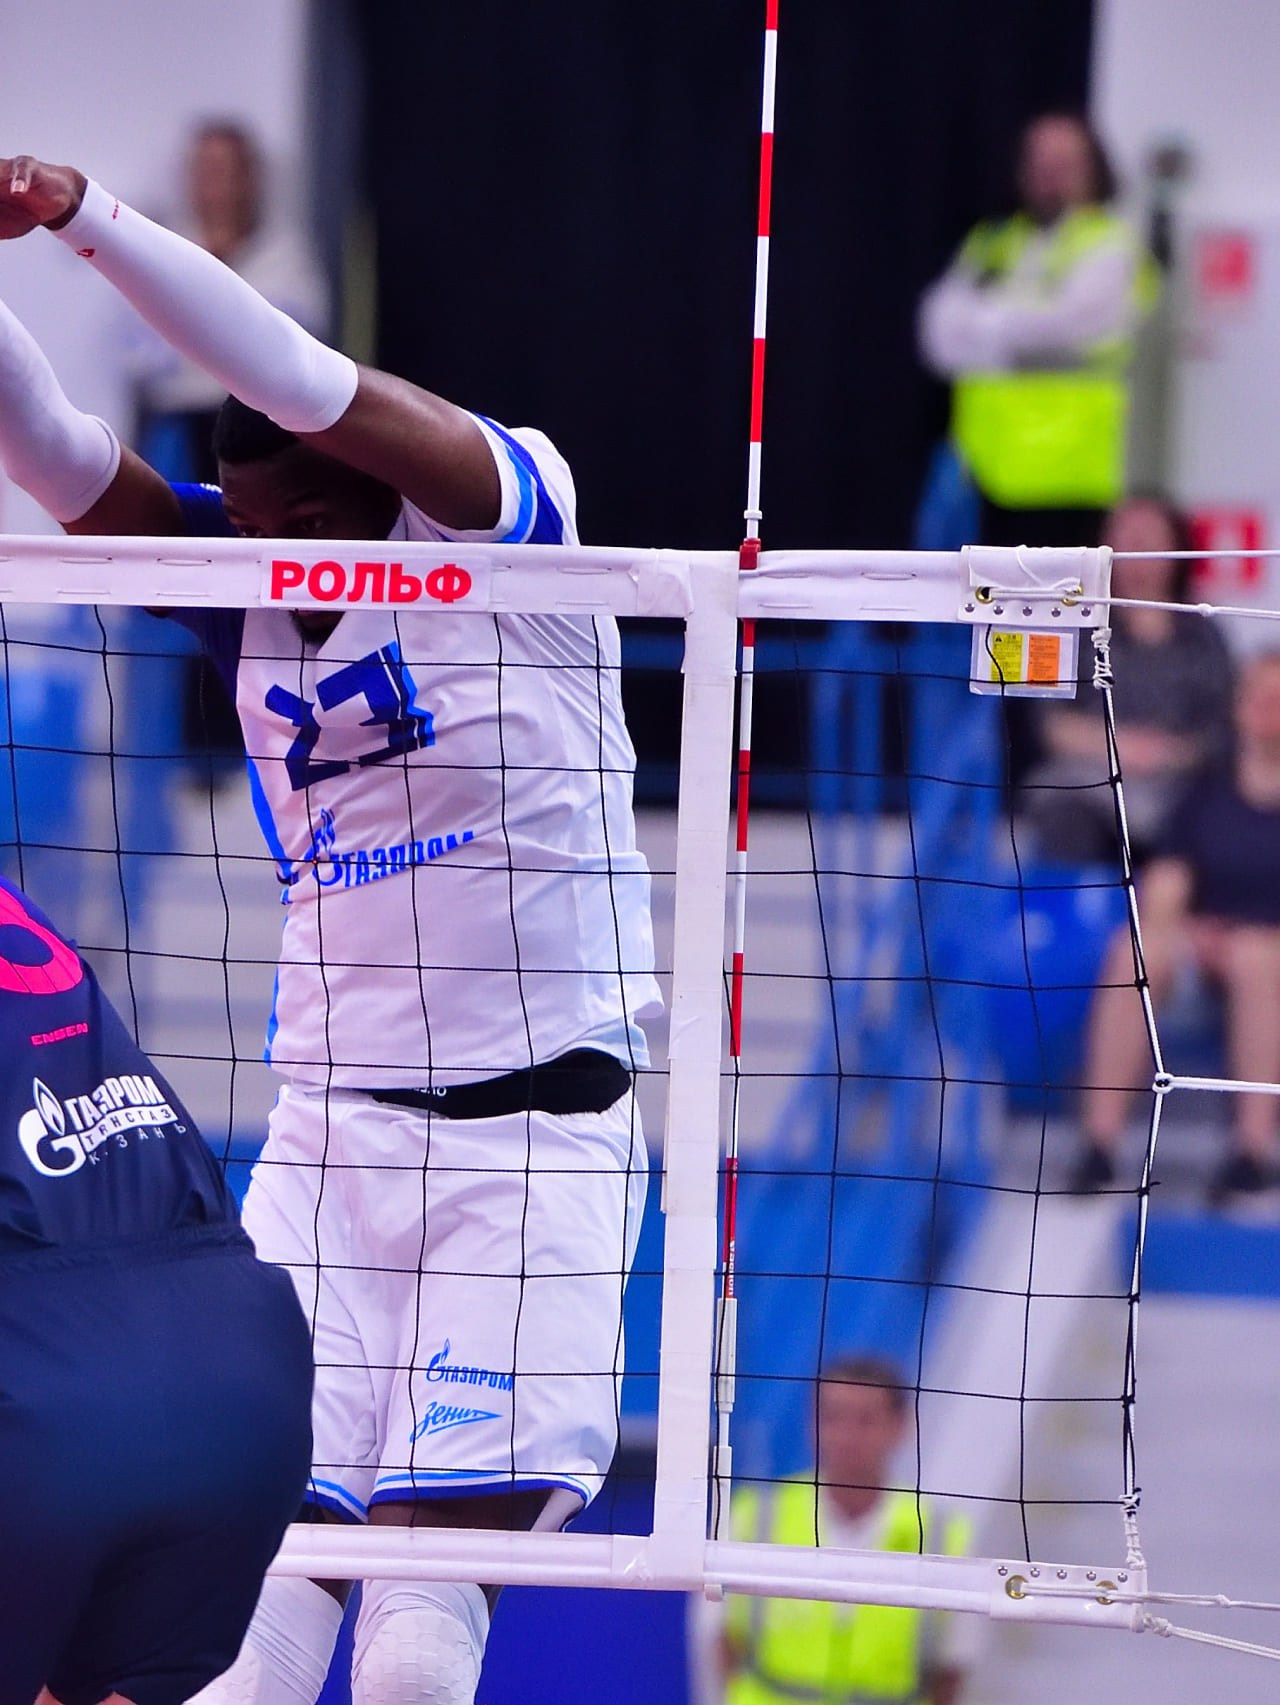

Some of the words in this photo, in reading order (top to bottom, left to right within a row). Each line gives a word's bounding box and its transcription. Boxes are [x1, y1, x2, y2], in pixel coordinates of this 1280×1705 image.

[270, 560, 474, 604] РОЛЬФ
[64, 1075, 166, 1132] ГАЗРОМ
[89, 1122, 187, 1165] КЗАНЬ
[445, 1366, 514, 1392] ГАЗПРОМ
